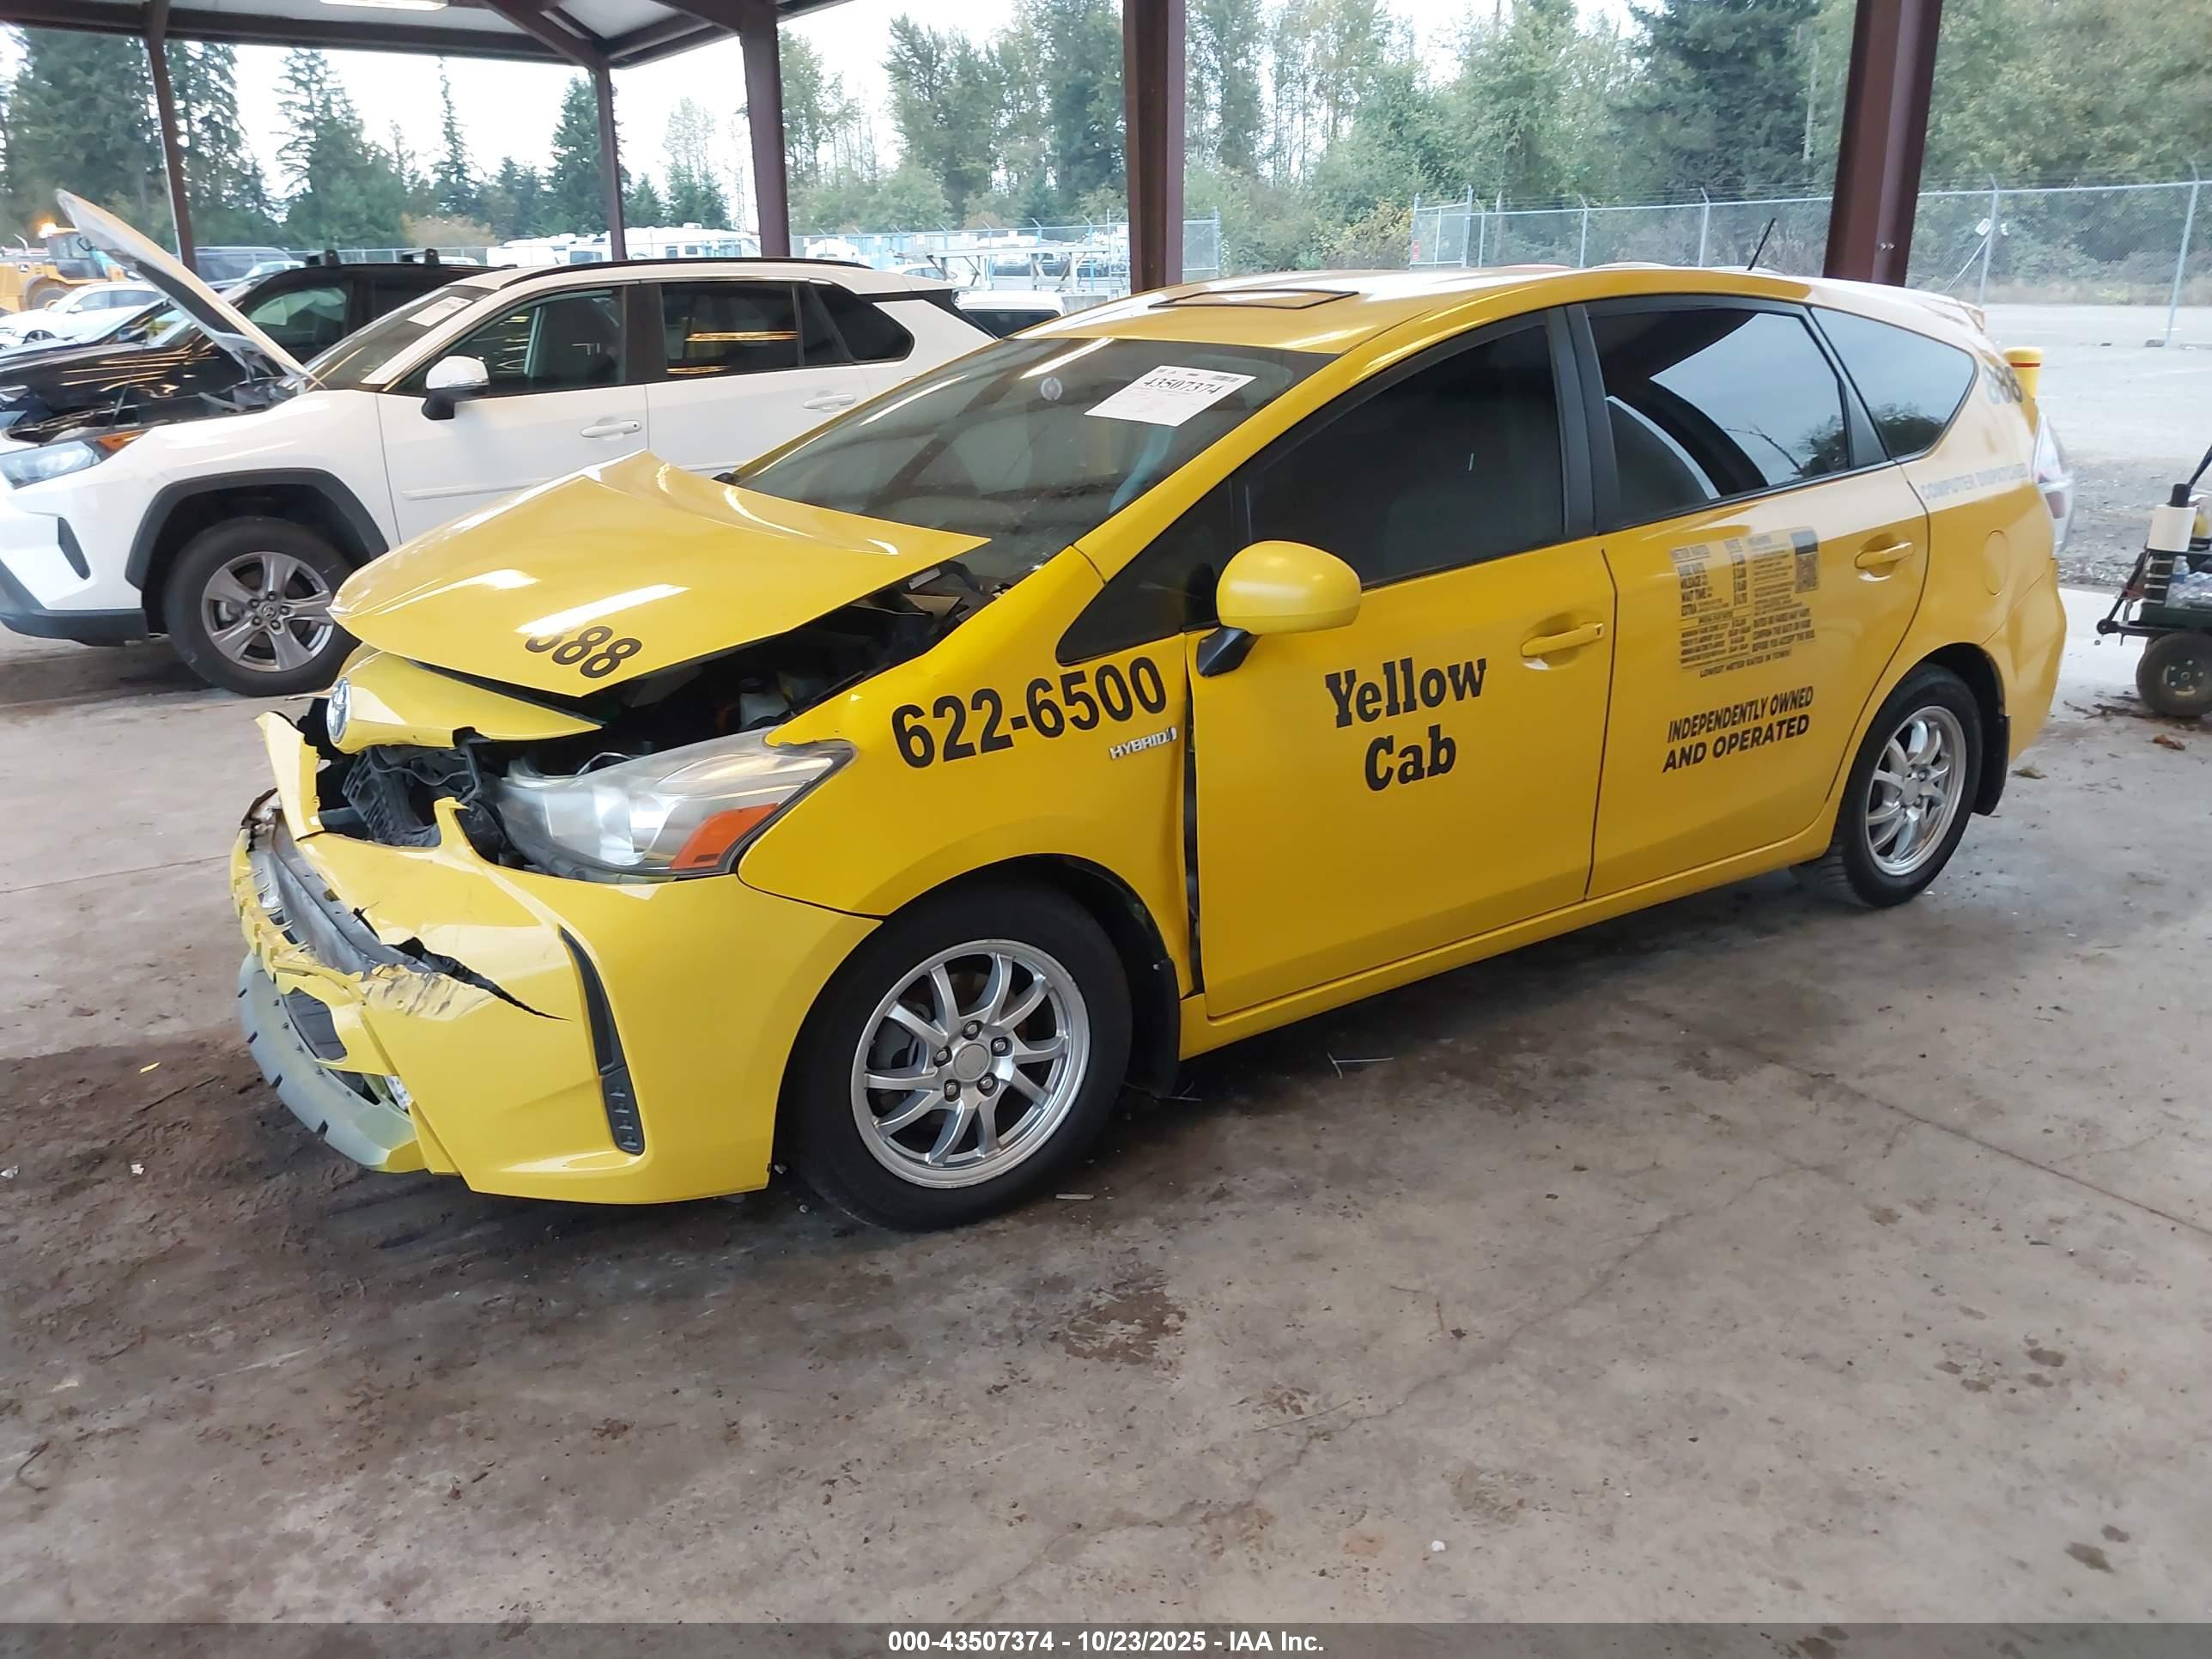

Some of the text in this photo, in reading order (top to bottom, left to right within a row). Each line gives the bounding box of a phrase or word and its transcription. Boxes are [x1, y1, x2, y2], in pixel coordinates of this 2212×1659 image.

[1144, 377, 1224, 395] 43507374
[891, 656, 1167, 769] 622-6500
[1325, 657, 1487, 728] Yellow
[1668, 685, 1814, 743] INDEPENDENTLY OWNED
[1109, 731, 1167, 760] HYBRID
[1364, 724, 1457, 792] Cab
[1662, 714, 1810, 773] AND OPERATED
